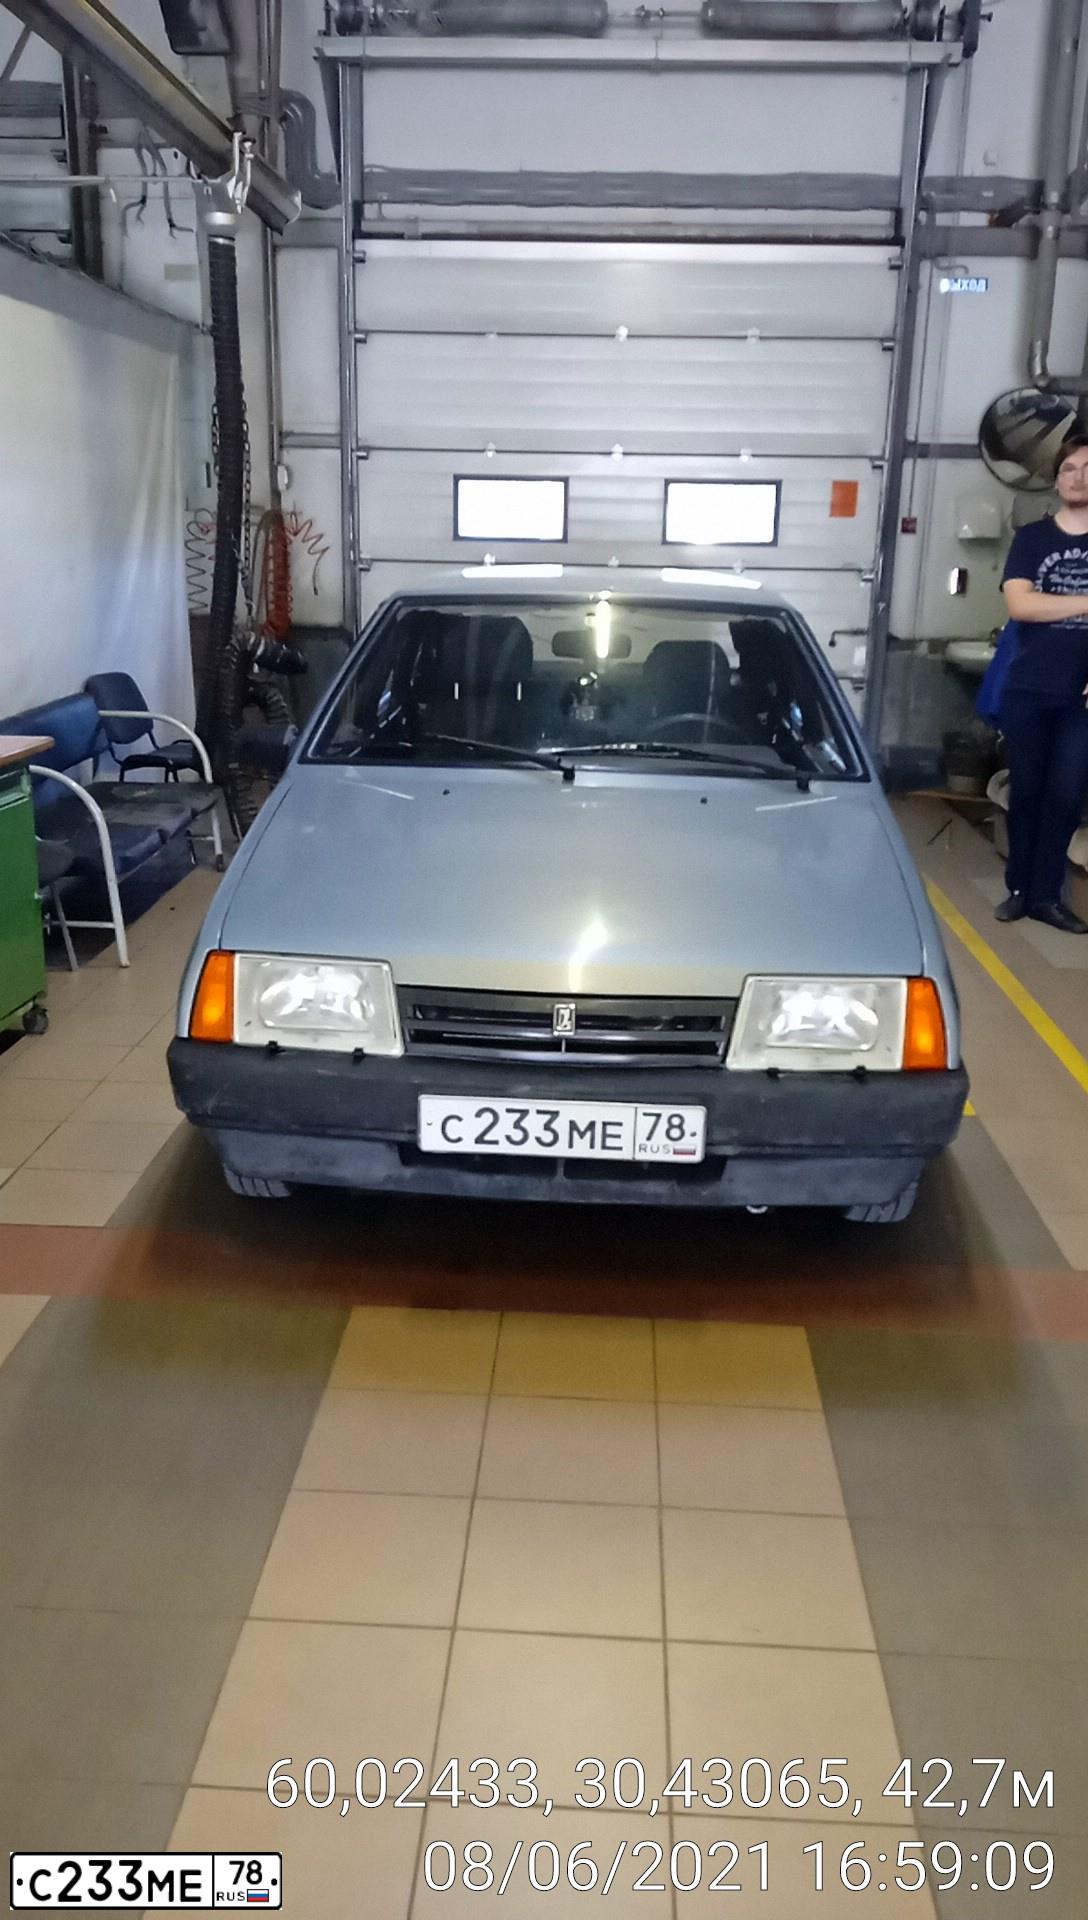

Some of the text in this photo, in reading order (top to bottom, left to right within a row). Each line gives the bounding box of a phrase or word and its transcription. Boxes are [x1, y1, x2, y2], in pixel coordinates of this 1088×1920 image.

[940, 278, 986, 293] ЫХОД
[440, 1106, 686, 1152] С233МЕ 78
[638, 1143, 671, 1156] RUS
